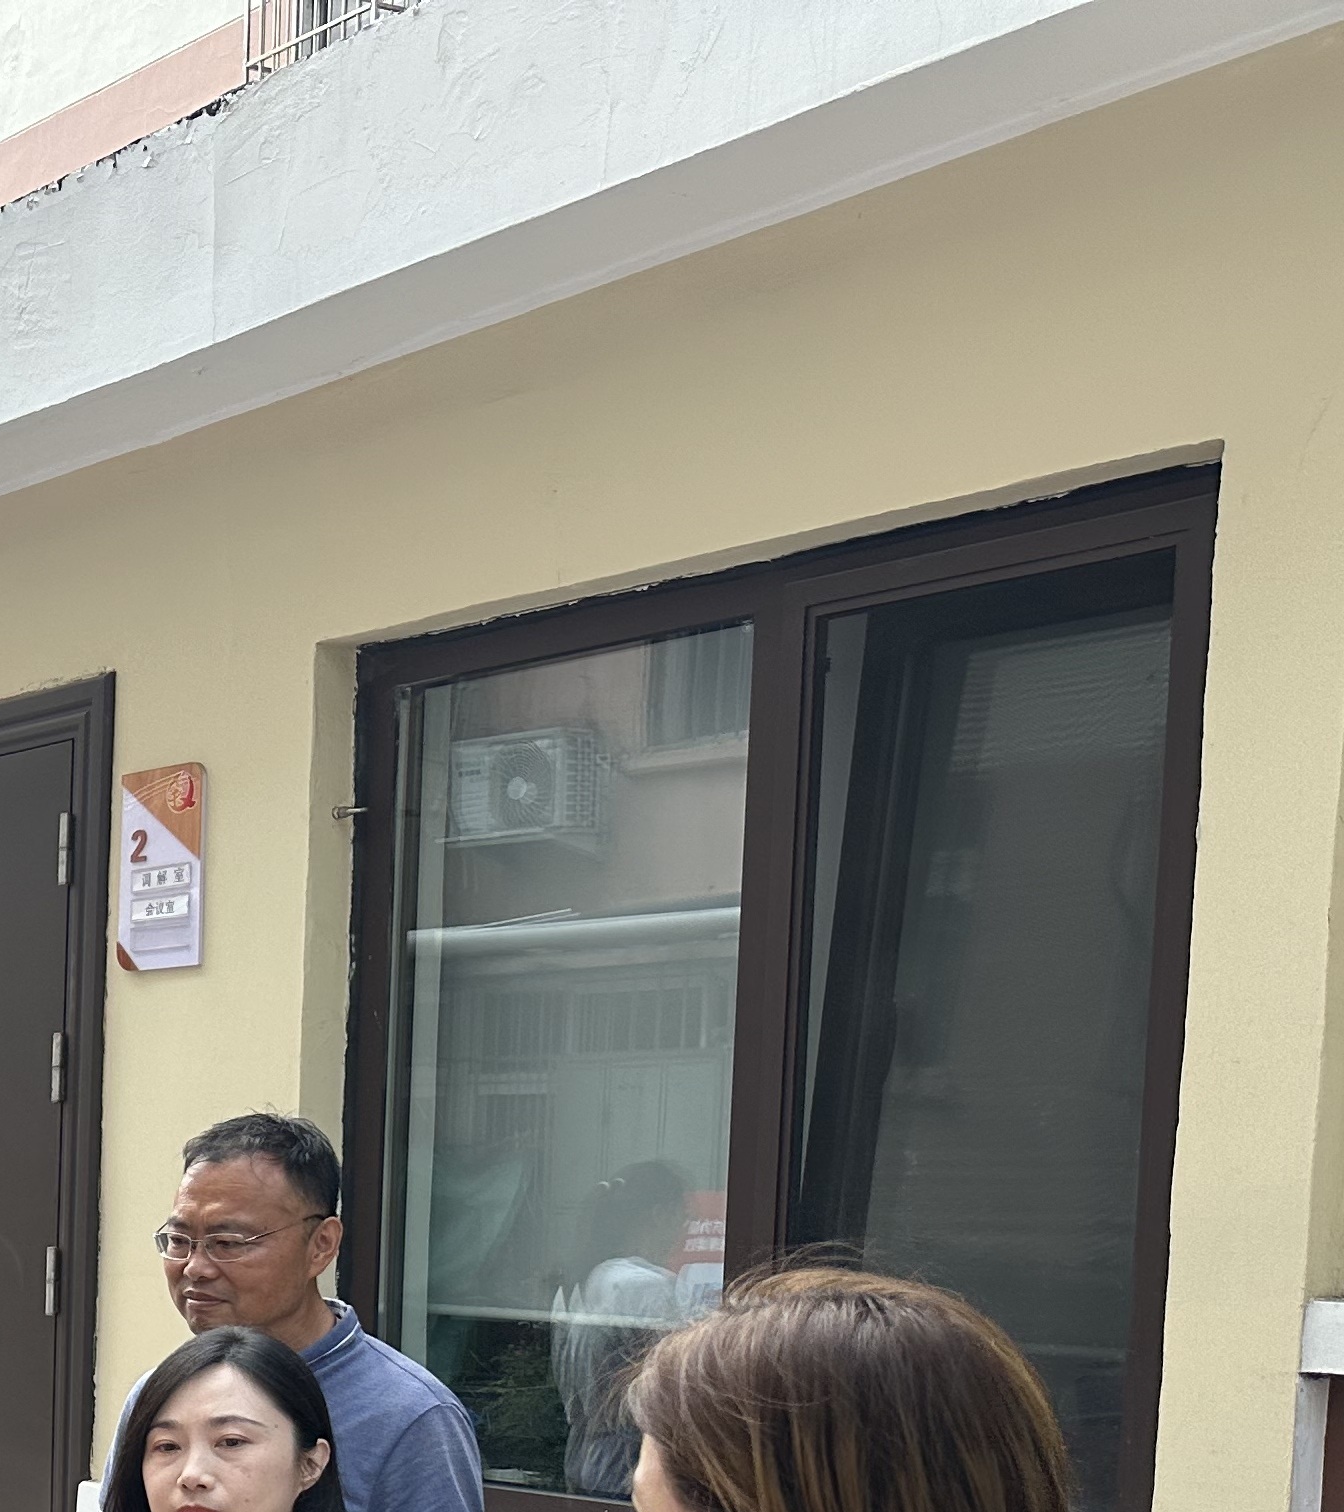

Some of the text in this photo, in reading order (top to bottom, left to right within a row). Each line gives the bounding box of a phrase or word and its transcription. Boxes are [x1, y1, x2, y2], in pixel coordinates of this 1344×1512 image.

[130, 829, 148, 863] 2
[145, 899, 175, 917] 会议室
